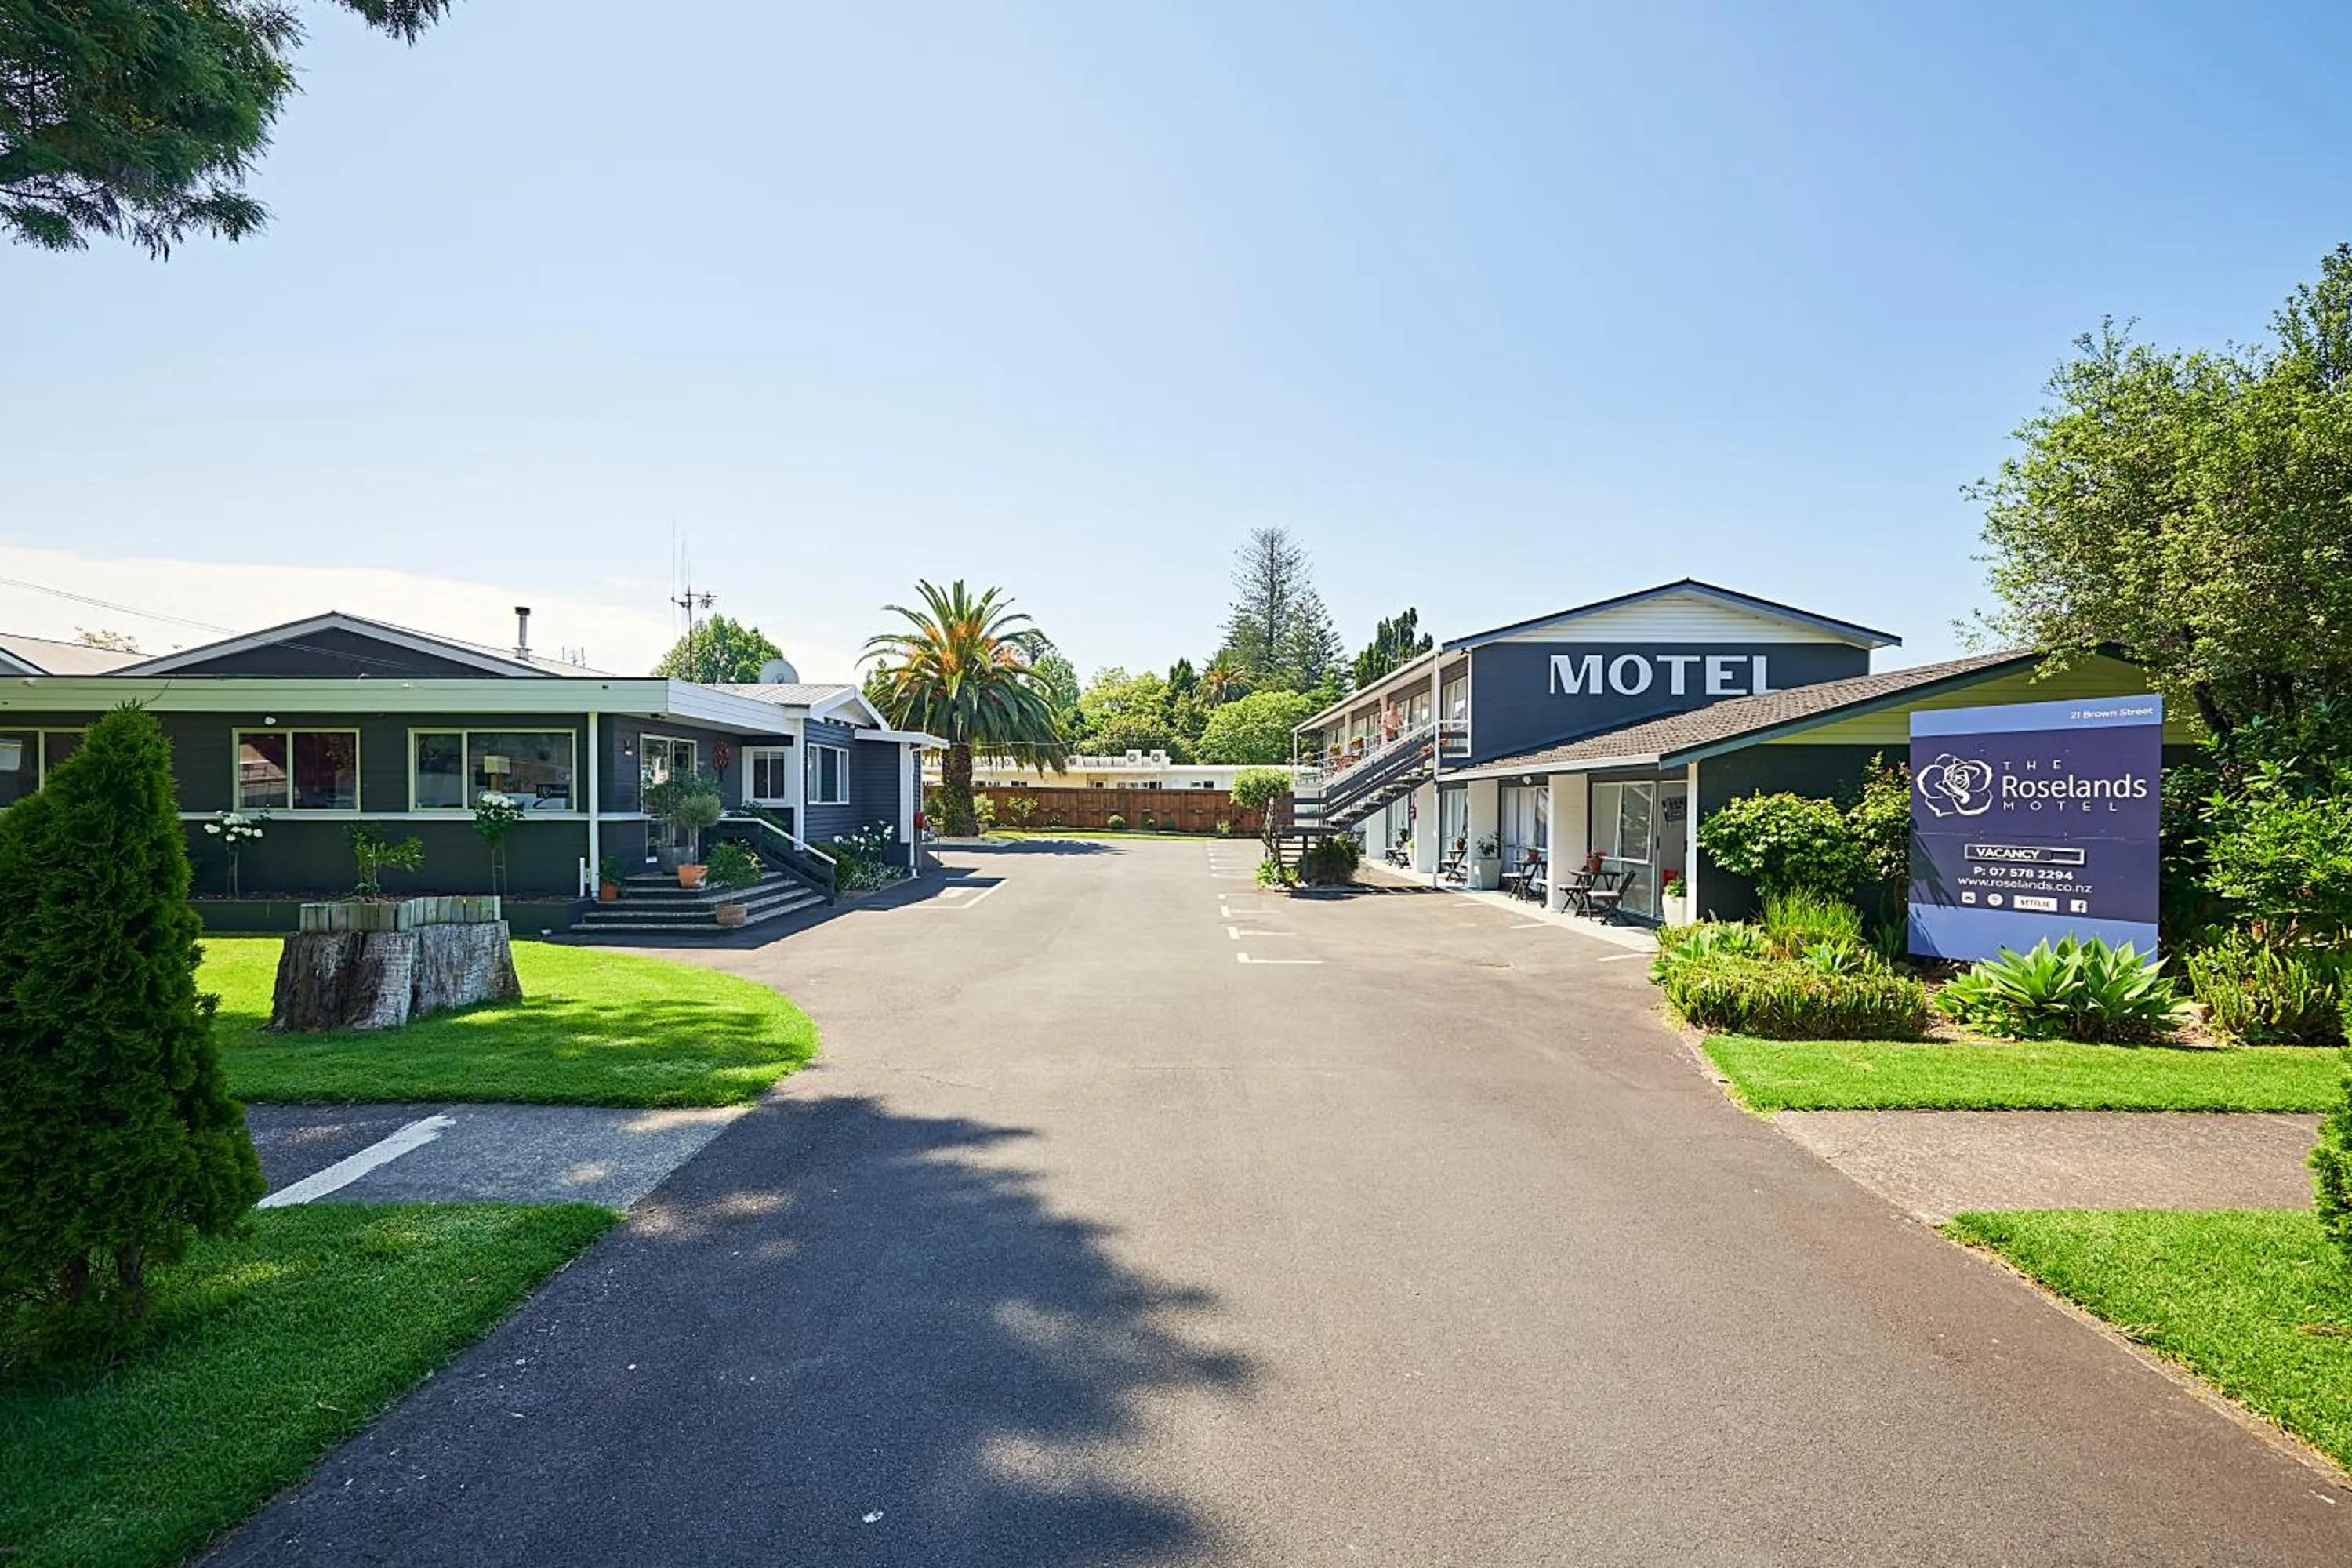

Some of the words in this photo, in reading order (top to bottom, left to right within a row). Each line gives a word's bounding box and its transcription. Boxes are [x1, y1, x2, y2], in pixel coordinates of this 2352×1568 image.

[1549, 654, 1782, 695] MOTEL
[2083, 710, 2117, 719] Brown
[2003, 760, 2062, 771] THE
[2002, 773, 2147, 798] Roselands
[2002, 800, 2118, 811] MOTEL
[1976, 848, 2040, 859] VACANCY
[1973, 866, 1986, 876] P:
[1989, 868, 2006, 877] 07
[2009, 868, 2034, 878] 578
[2038, 869, 2074, 880] 2294
[1958, 877, 2092, 894] www.roselands.co.nz
